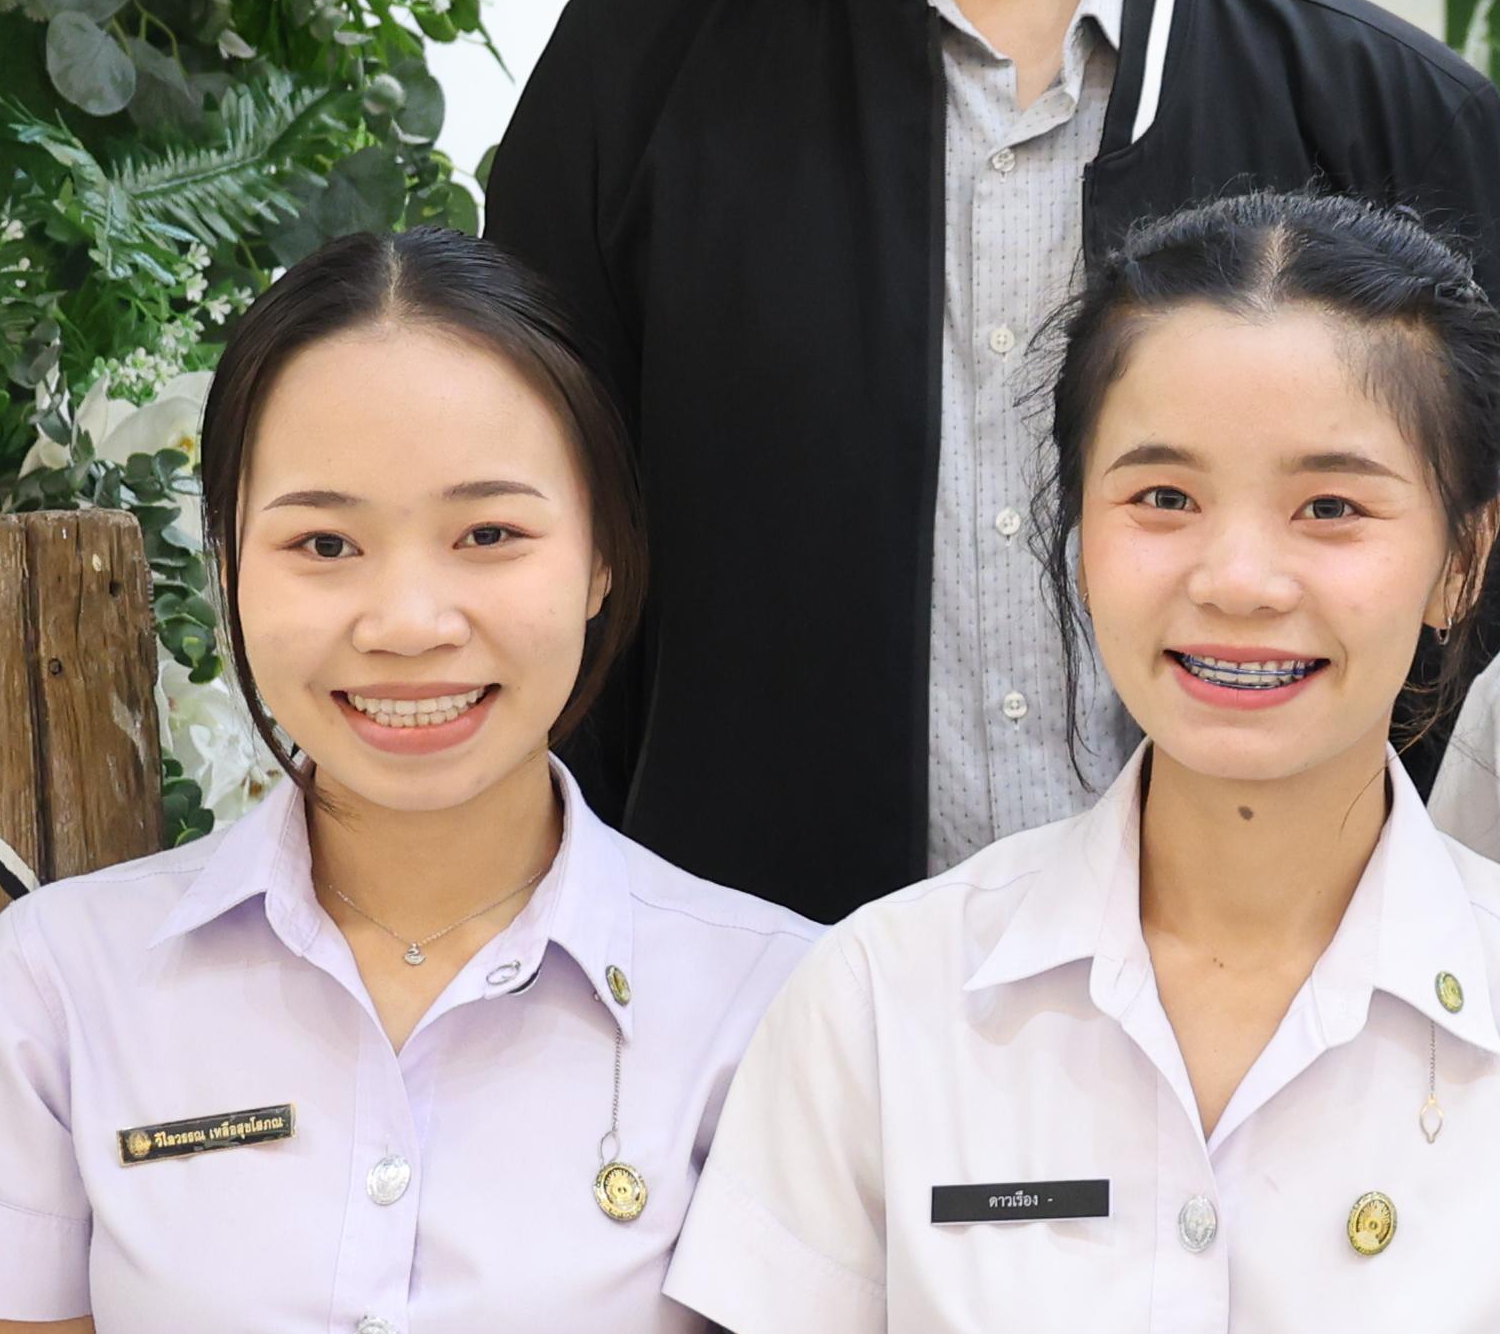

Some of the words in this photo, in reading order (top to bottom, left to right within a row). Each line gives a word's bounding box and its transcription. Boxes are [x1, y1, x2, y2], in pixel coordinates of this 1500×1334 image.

[154, 1130, 206, 1148] วิไลวรรณ
[989, 1190, 1038, 1207] ดาวเรือง
